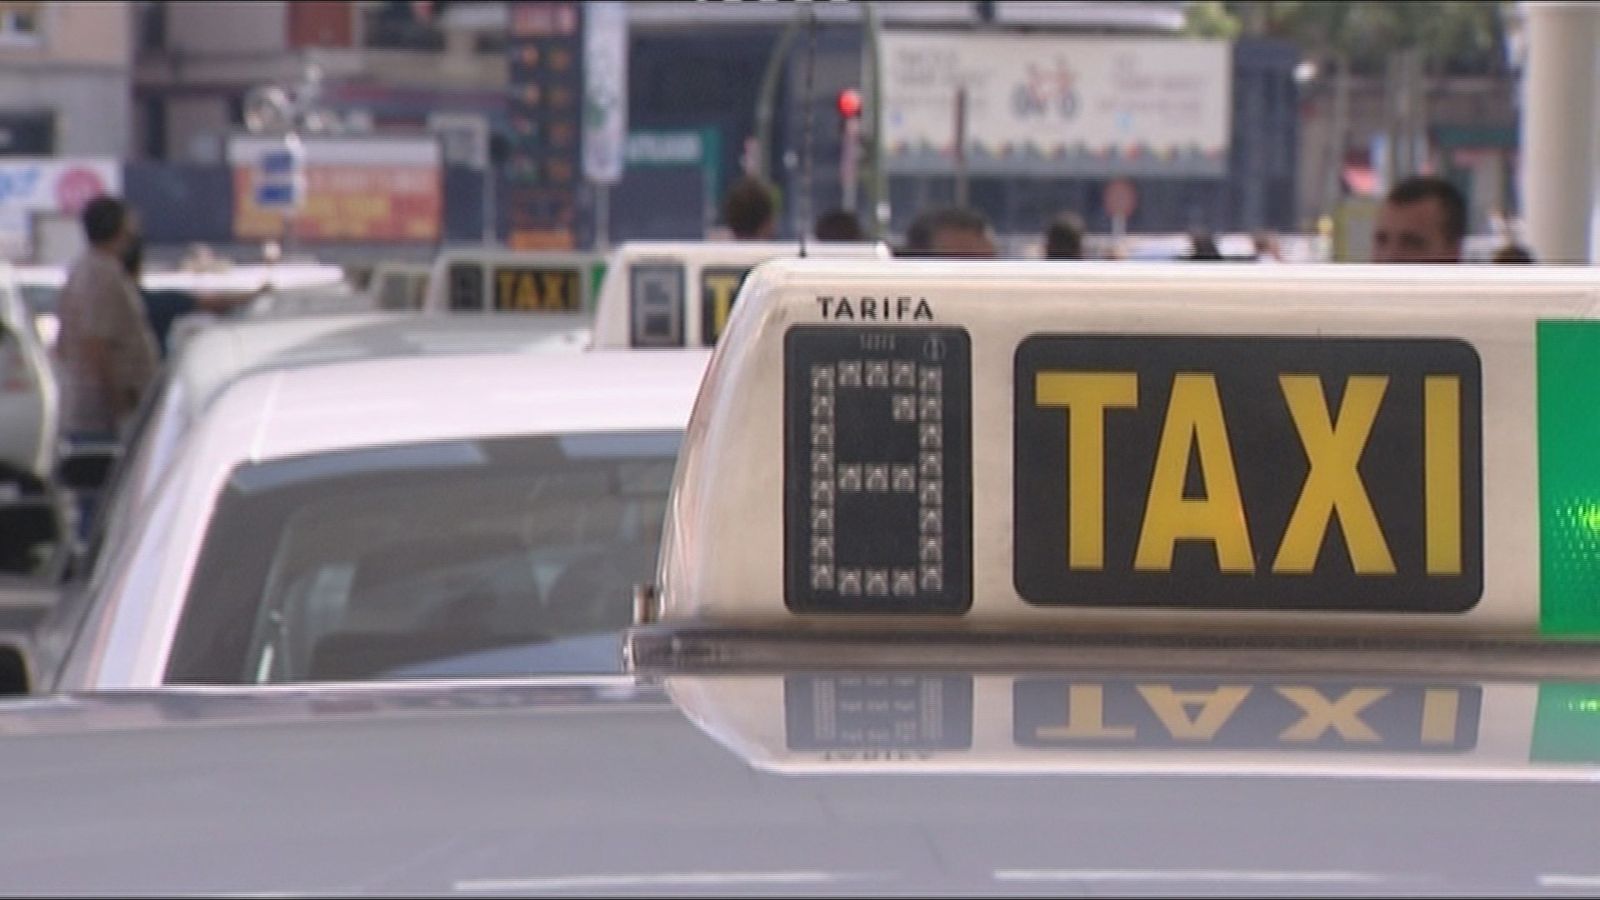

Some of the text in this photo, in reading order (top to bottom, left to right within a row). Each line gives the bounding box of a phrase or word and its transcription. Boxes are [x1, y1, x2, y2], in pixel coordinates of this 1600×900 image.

[498, 271, 579, 311] TAXI
[816, 297, 934, 320] TARIFA
[1035, 371, 1462, 577] TAXI
